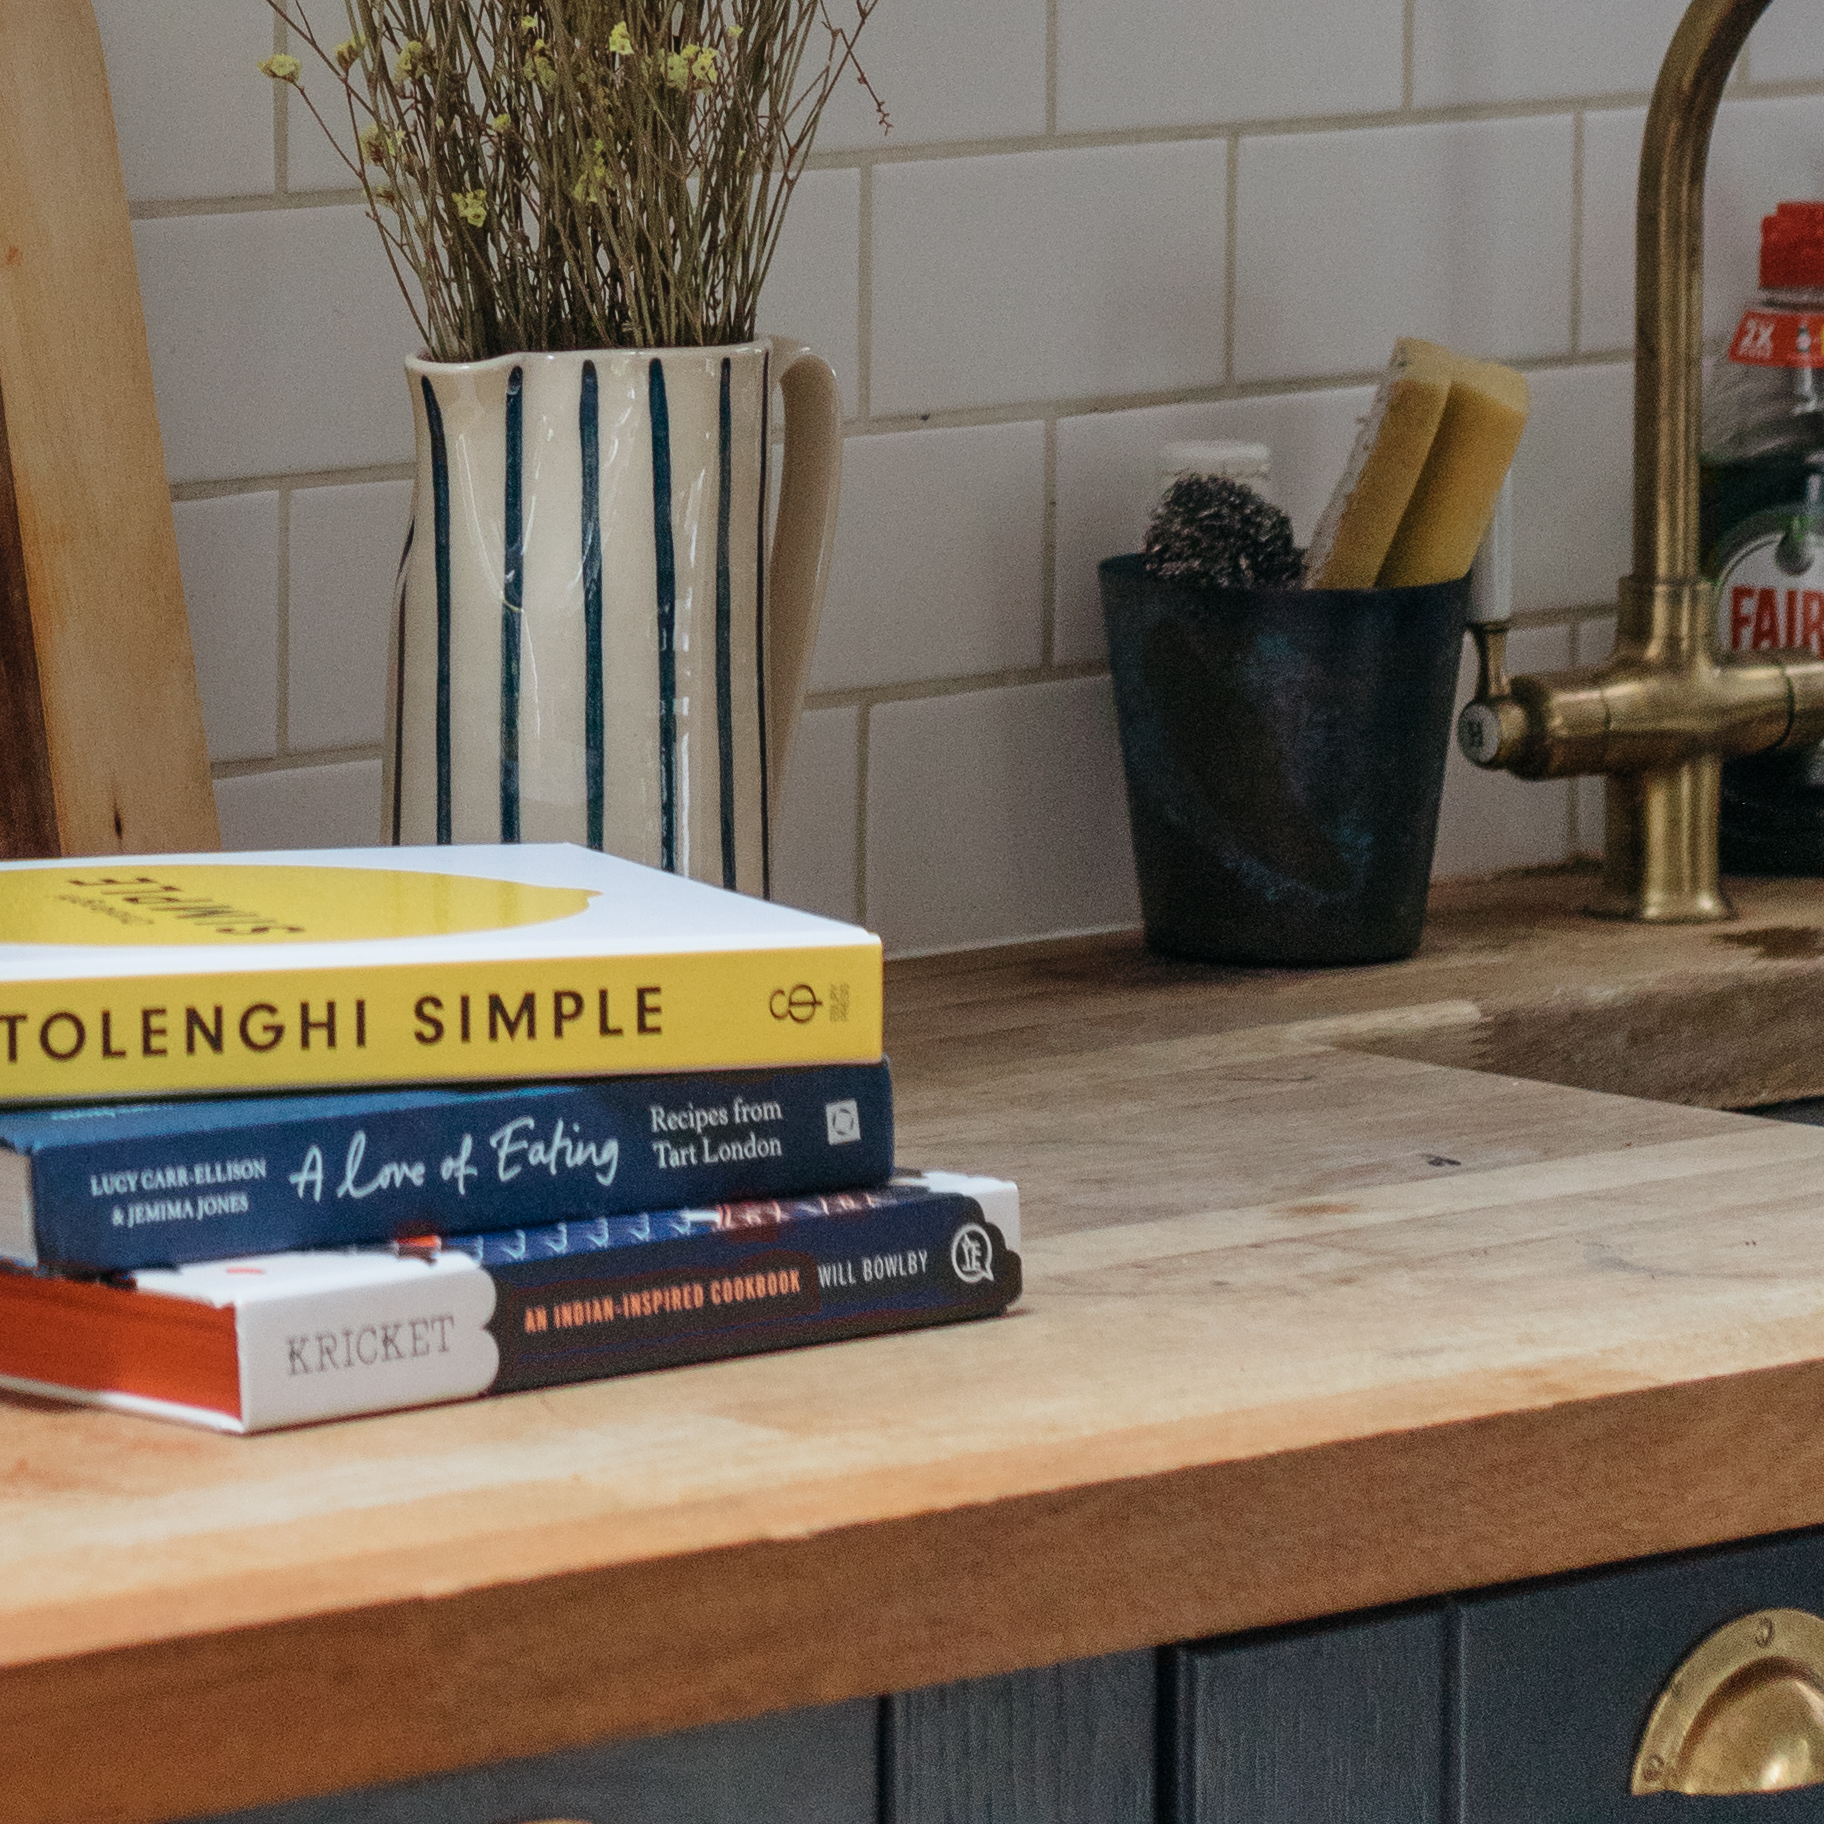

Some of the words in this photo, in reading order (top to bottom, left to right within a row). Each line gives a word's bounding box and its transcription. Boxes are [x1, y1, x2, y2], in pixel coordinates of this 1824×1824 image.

[413, 985, 664, 1046] SIMPLE
[650, 1102, 729, 1135] Recipes
[733, 1095, 783, 1126] from
[289, 1145, 324, 1202] A
[440, 1134, 477, 1195] of
[489, 1115, 620, 1187] Eating
[652, 1139, 697, 1169] Tart
[702, 1131, 784, 1164] London
[91, 1172, 139, 1197] LUCY
[141, 1158, 267, 1194] CARR-ELLISON
[111, 1208, 125, 1227] &
[126, 1199, 196, 1228] JEMIMA
[197, 1192, 249, 1219] JONES
[524, 1306, 549, 1333] AN
[554, 1282, 704, 1329] INDIAN-INSPIRED
[709, 1269, 801, 1306] COOKBOOK
[817, 1255, 857, 1289] WILL
[863, 1249, 929, 1283] BOWLBY
[287, 1314, 456, 1376] KRICKET
